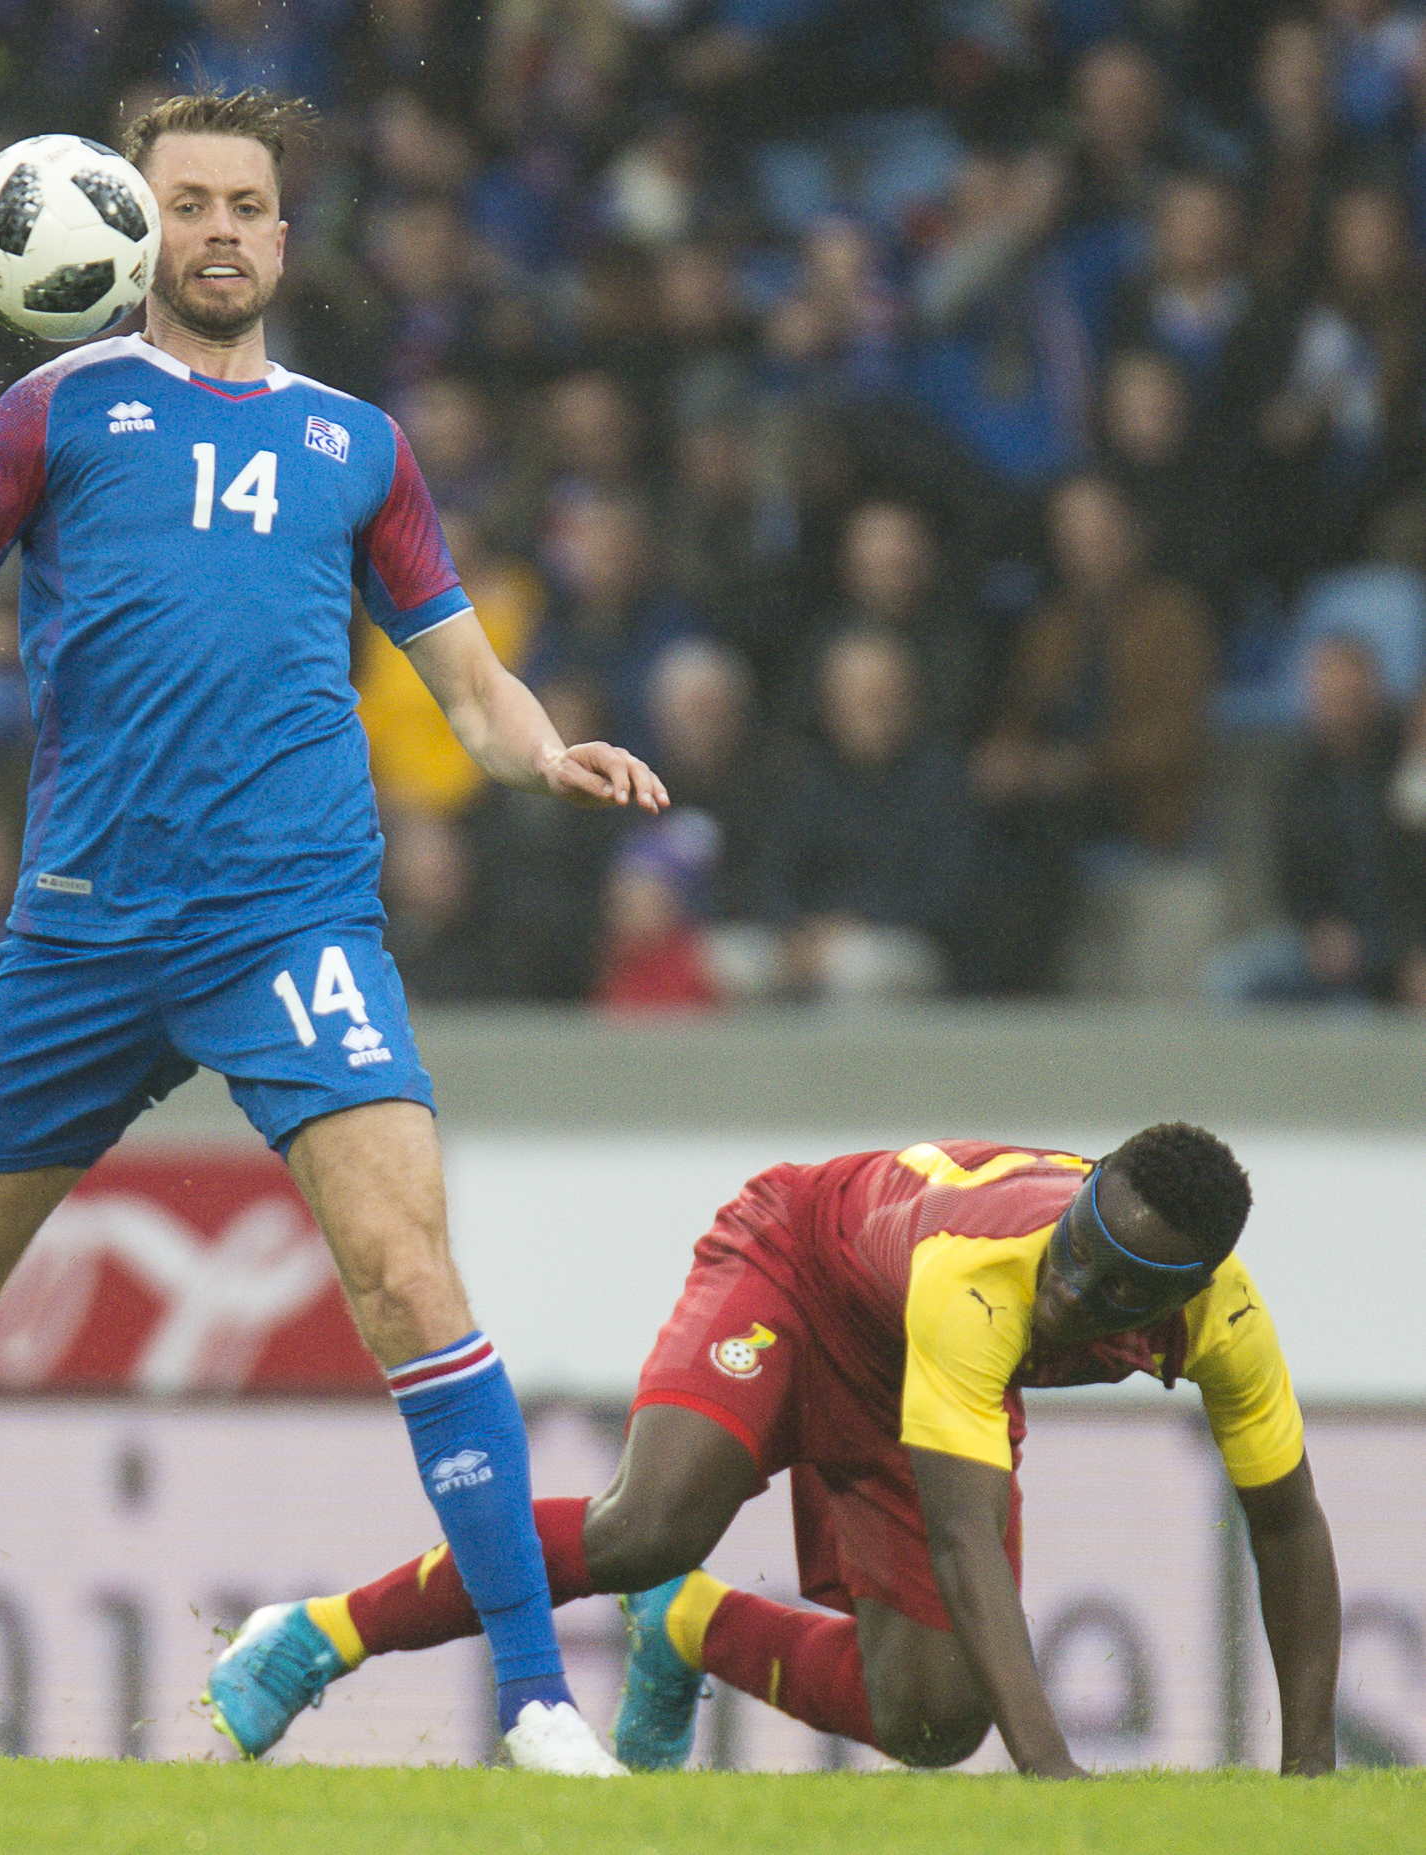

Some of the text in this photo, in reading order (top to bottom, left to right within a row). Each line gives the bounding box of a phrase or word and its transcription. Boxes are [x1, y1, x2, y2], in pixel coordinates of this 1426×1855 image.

[109, 418, 156, 433] errea
[193, 442, 278, 534] 14
[273, 945, 370, 1048] 14
